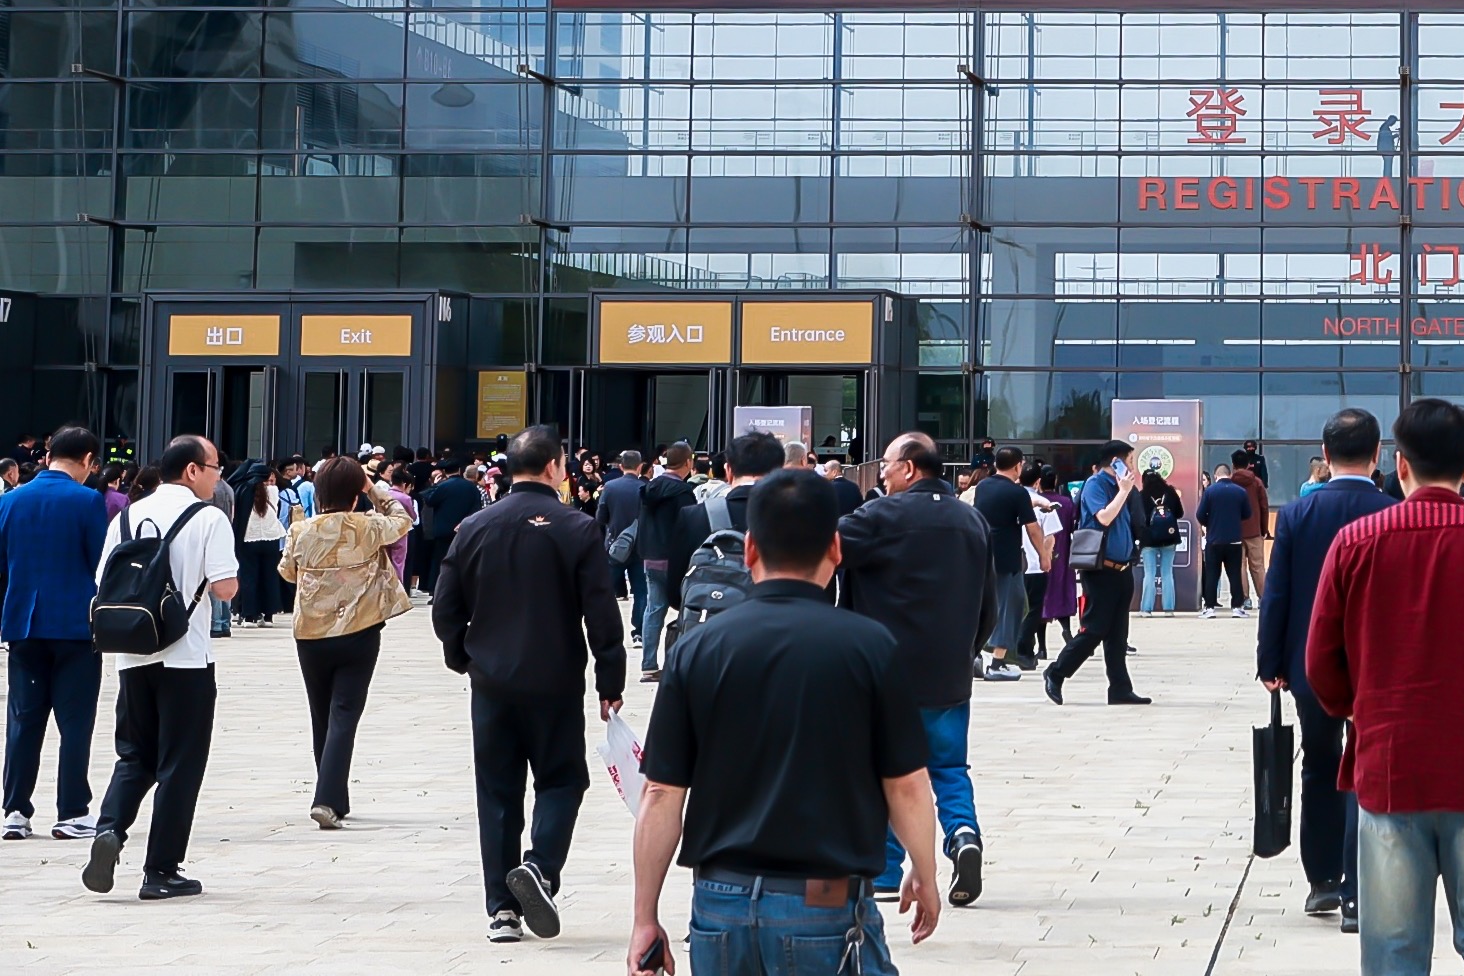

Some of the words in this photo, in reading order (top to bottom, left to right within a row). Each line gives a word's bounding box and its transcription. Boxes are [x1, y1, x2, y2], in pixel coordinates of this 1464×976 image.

[1349, 242, 1462, 287] 北门
[205, 326, 244, 346] 出口
[340, 328, 372, 344] Exit
[627, 324, 704, 345] 参观入口
[770, 326, 845, 343] Entrance
[1323, 317, 1400, 336] NORTH
